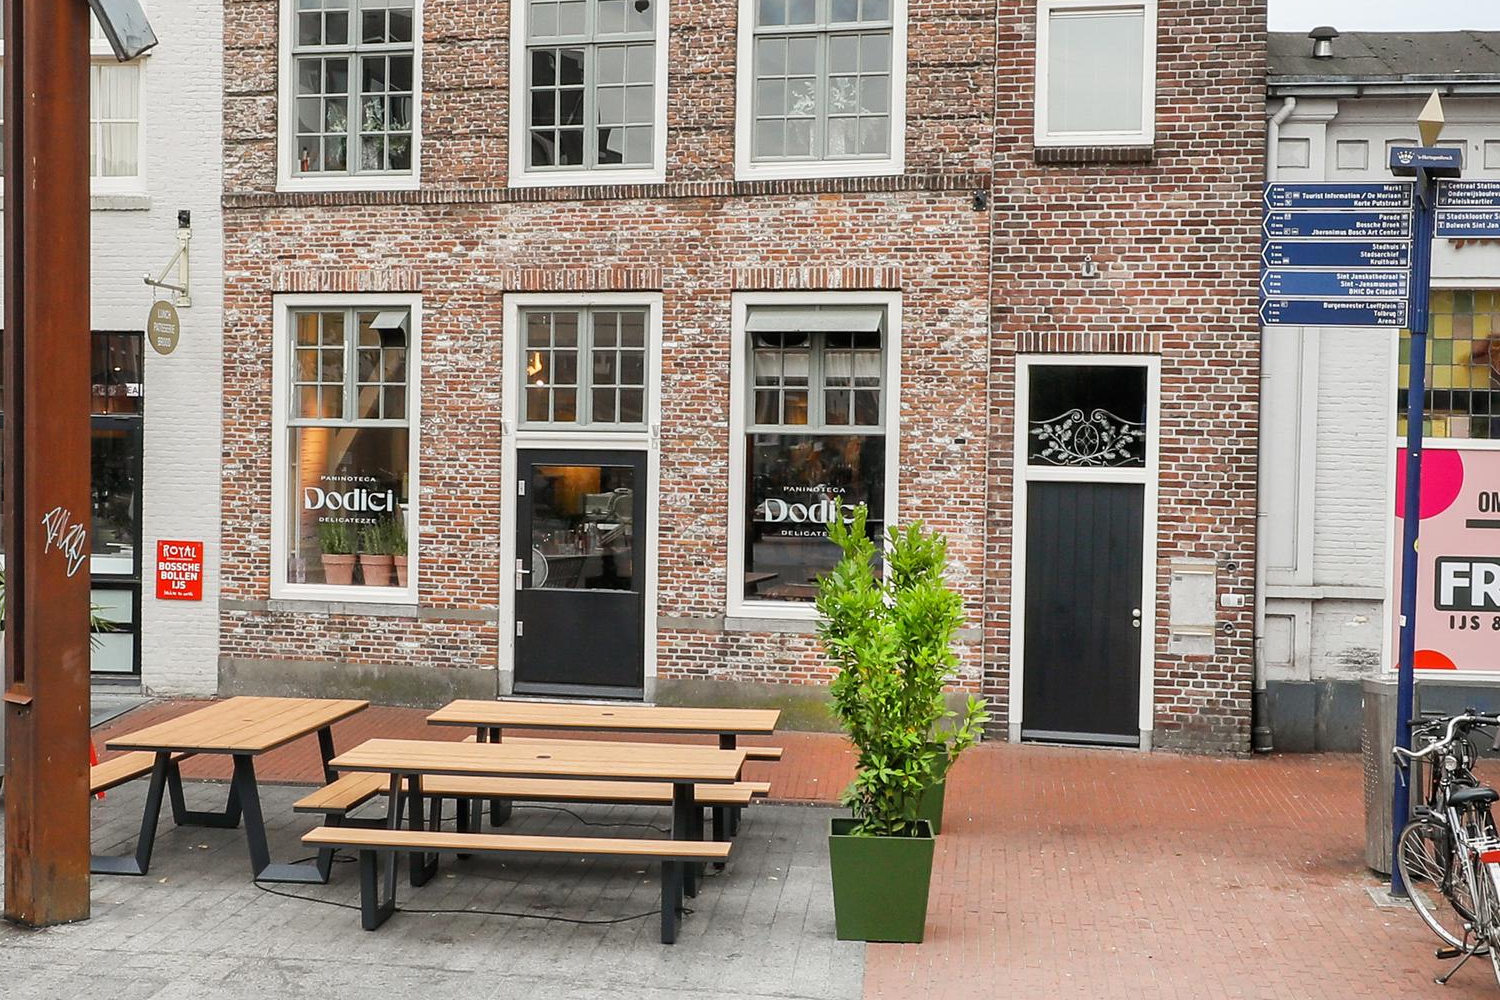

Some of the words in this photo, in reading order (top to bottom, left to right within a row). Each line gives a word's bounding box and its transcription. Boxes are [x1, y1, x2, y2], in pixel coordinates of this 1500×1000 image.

[1373, 310, 1396, 318] Tolbrug
[304, 486, 393, 512] Dodici
[163, 544, 196, 557] ROYAL
[159, 561, 200, 572] BOSSCHE
[161, 571, 197, 580] BOLLEN
[172, 580, 186, 589] IJS
[1449, 615, 1480, 630] IJS
